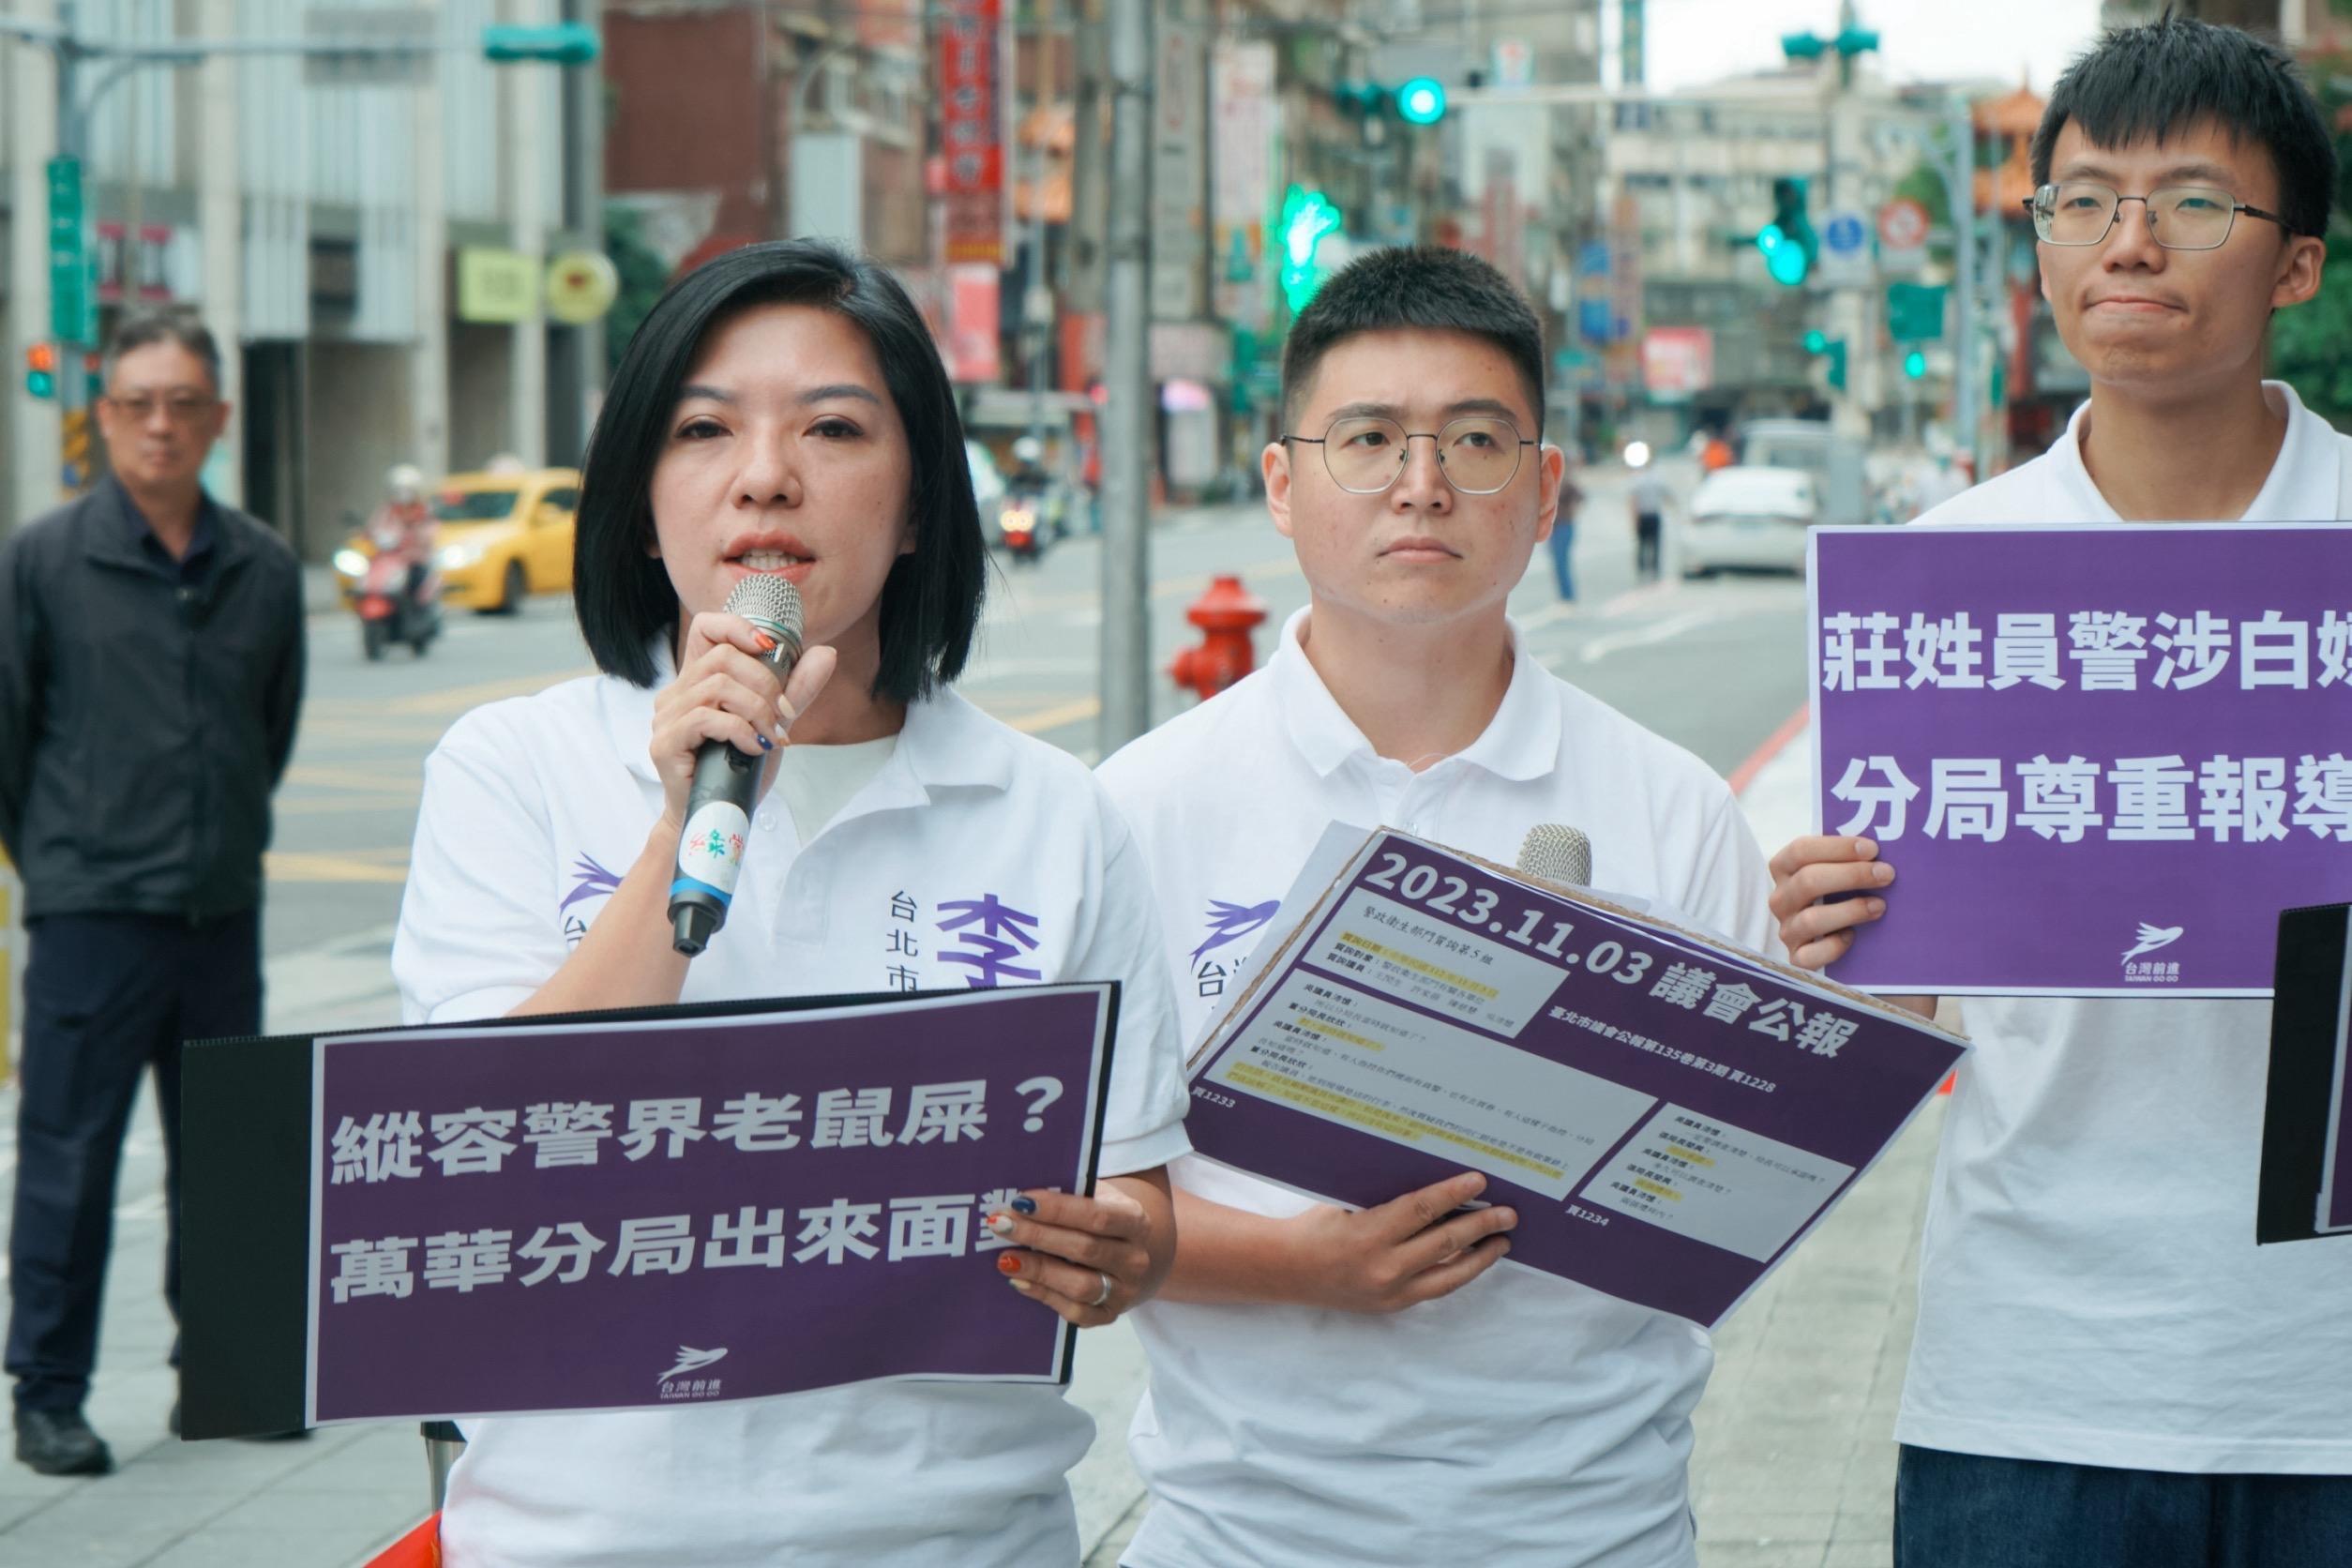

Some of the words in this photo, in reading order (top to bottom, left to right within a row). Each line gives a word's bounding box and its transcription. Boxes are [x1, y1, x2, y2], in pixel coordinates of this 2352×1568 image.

[1830, 753, 2352, 843] 分局尊重報導
[1364, 852, 1652, 985] 2023.11.03
[1649, 960, 1860, 1059] 議會公報
[2125, 962, 2180, 975] 台灣前進
[1547, 1004, 1728, 1079] 臺北市議會公報第135卷第3期
[1726, 1068, 1776, 1093] 頁1228
[1190, 1086, 1236, 1108] 頁1233
[330, 1076, 1064, 1185] 縱容警界老鼠屎？
[1565, 1204, 1609, 1227] 頁1234
[661, 1379, 721, 1393] 台灣前進
